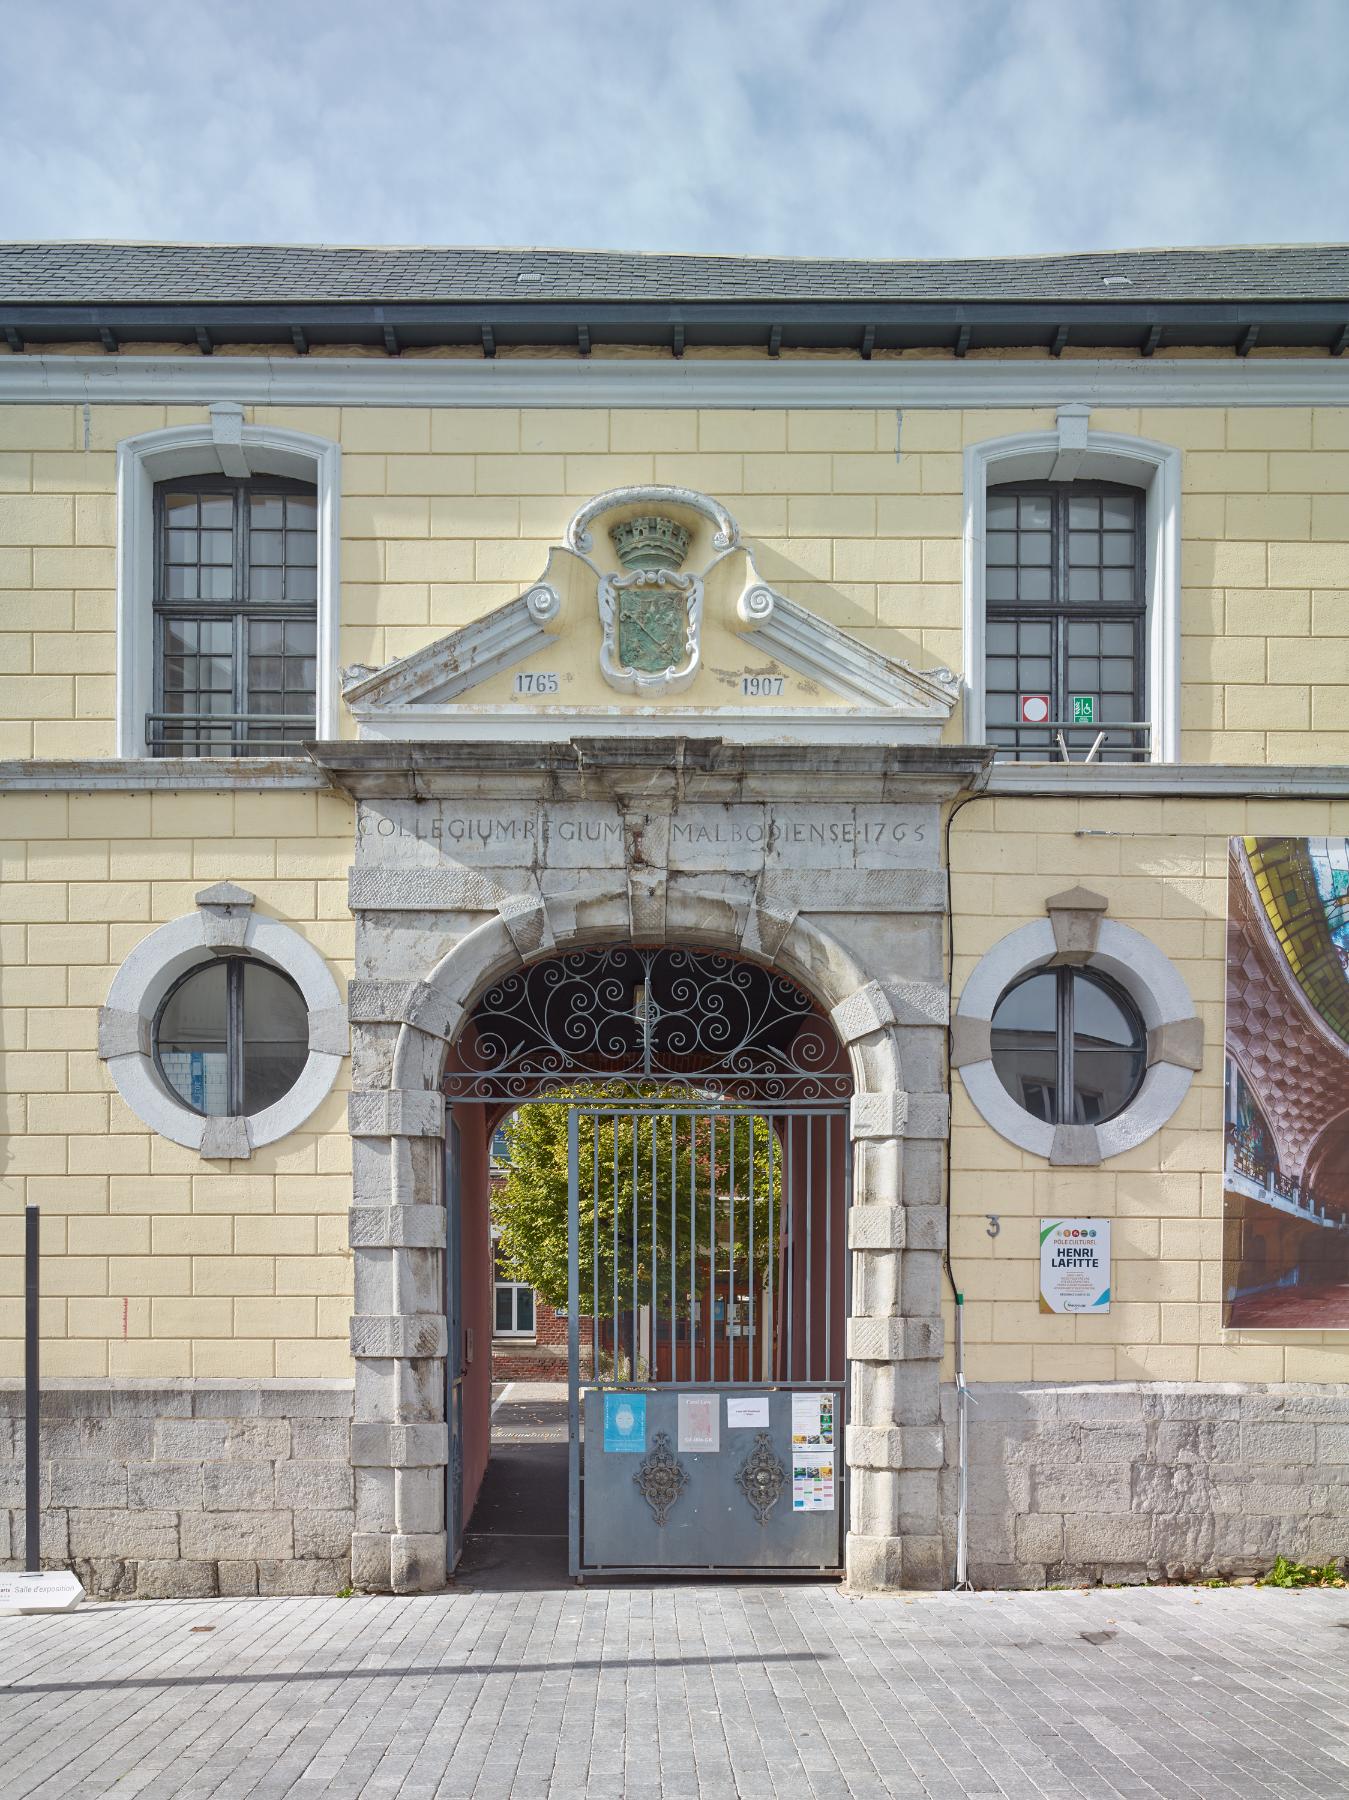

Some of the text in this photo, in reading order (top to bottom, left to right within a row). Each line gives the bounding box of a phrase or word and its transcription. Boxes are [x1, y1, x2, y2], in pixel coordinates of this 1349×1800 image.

[516, 674, 559, 693] 1765
[743, 677, 784, 696] 1907
[985, 1214, 1000, 1237] 3
[1057, 1248, 1093, 1258] HENRI
[1051, 1258, 1099, 1268] LAFITTE
